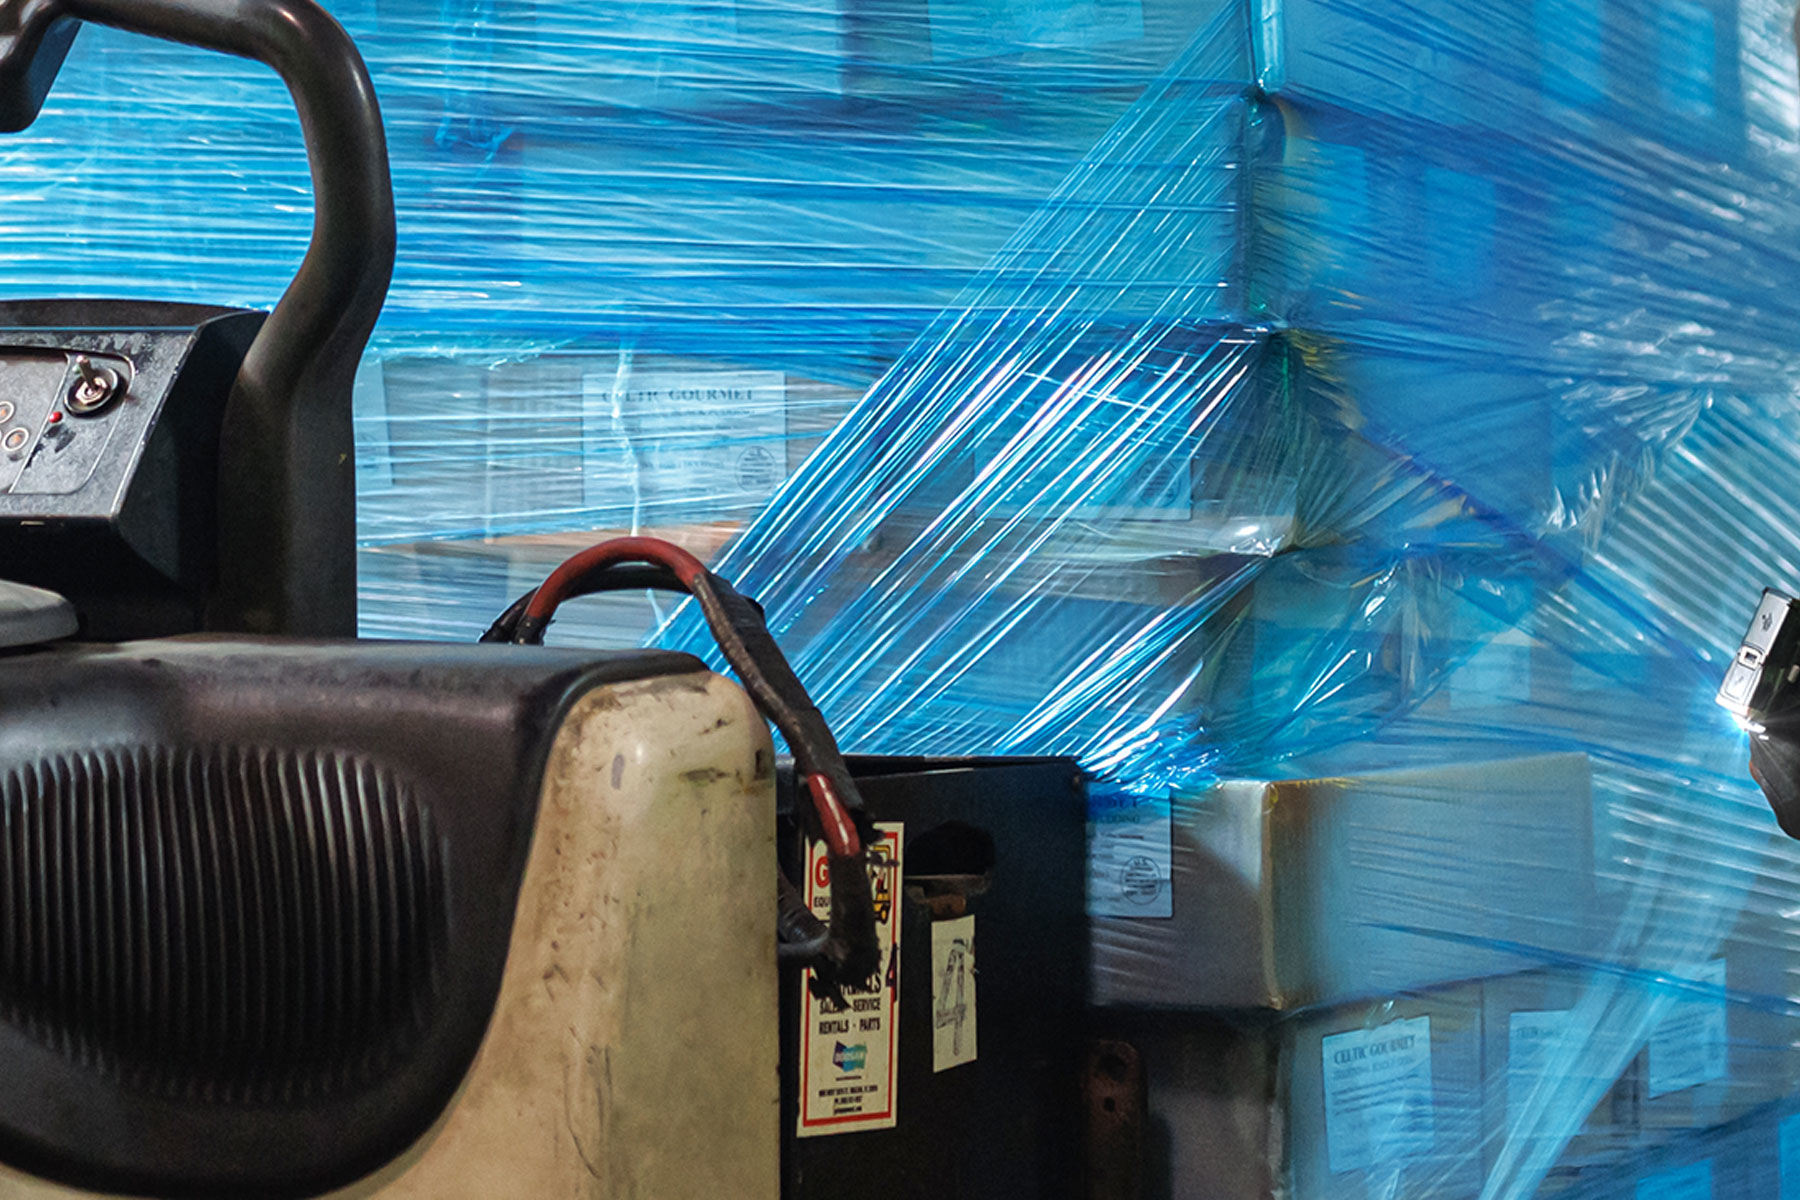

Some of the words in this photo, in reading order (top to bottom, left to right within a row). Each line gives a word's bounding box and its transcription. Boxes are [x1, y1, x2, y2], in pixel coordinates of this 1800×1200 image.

[668, 389, 753, 401] GOURMET
[853, 997, 881, 1013] SERVICE
[819, 1019, 849, 1035] RENTALS
[859, 1017, 881, 1032] PARTS
[1333, 1045, 1367, 1065] CELTIC
